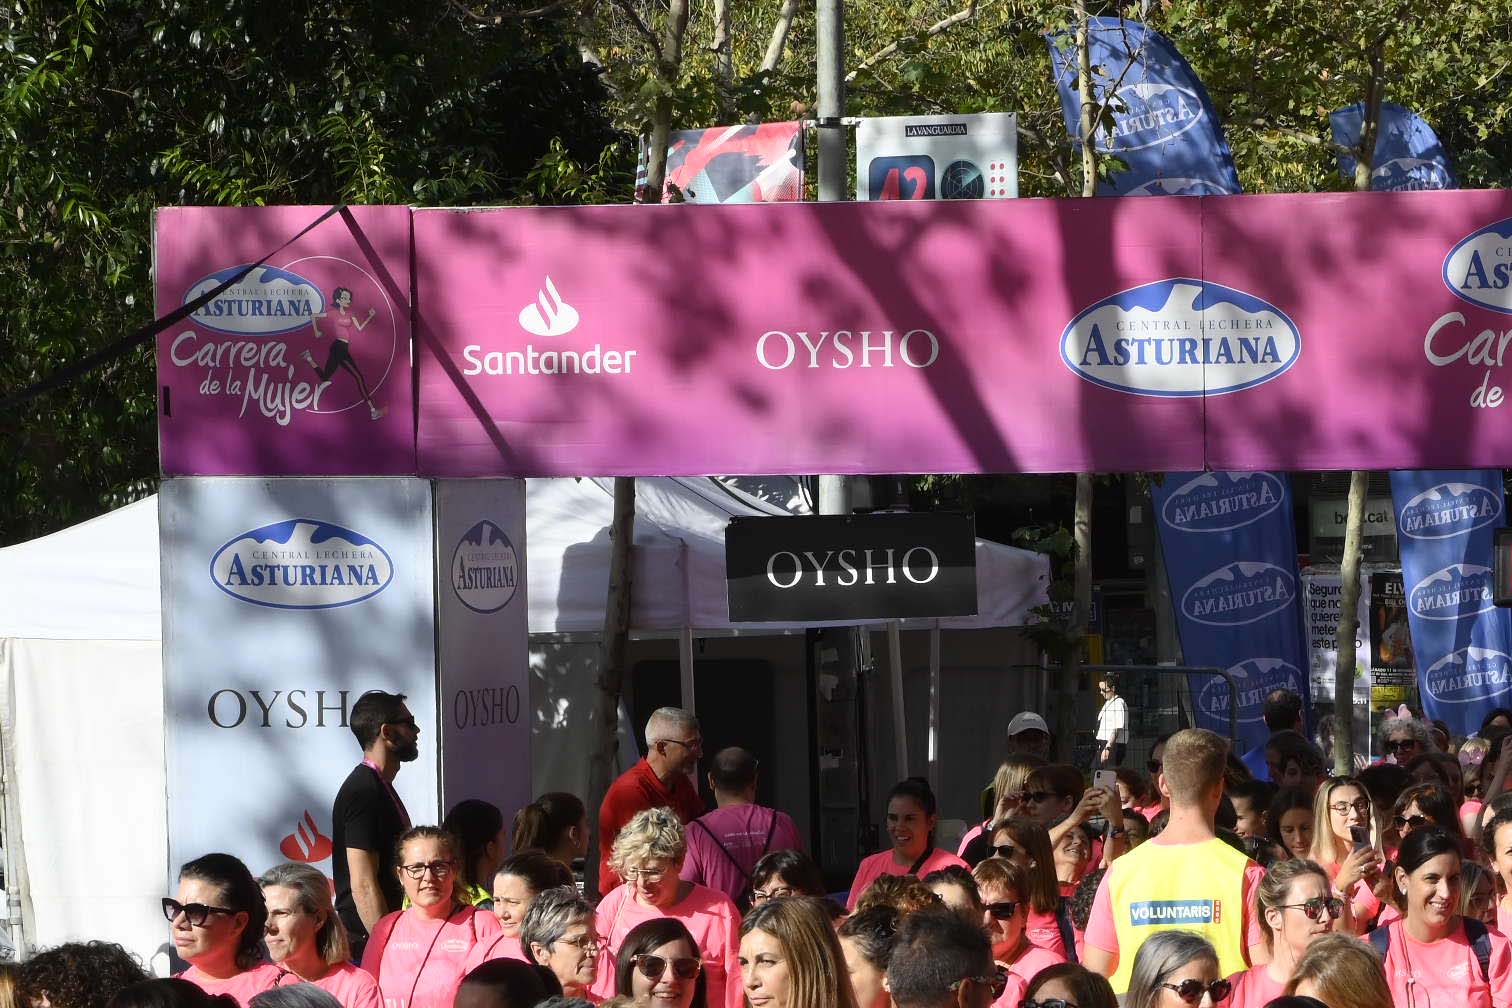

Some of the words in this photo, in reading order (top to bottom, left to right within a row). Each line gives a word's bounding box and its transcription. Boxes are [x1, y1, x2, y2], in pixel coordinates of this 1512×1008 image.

[194, 287, 313, 317] ASTURIANA
[220, 287, 259, 296] ENTRAL
[1116, 319, 1191, 331] CENTRAL
[1199, 318, 1273, 330] LECHERA
[170, 331, 288, 367] Carrera
[463, 343, 637, 375] Santander
[755, 328, 940, 370] OYSHO
[1079, 323, 1282, 366] ASTURIANA
[200, 369, 220, 395] de
[226, 368, 241, 395] la
[239, 365, 332, 426] Mujer
[1470, 369, 1504, 408] de
[225, 553, 381, 587] ASTURIANA
[252, 551, 310, 560] CENTRAL
[315, 550, 374, 559] LECHERA
[766, 546, 939, 589] OYSHO
[456, 560, 517, 592] ASTURIANA
[207, 688, 391, 729] OYSH
[454, 685, 520, 731] OYSHO
[1131, 904, 1211, 922] VOLUNTARIS
